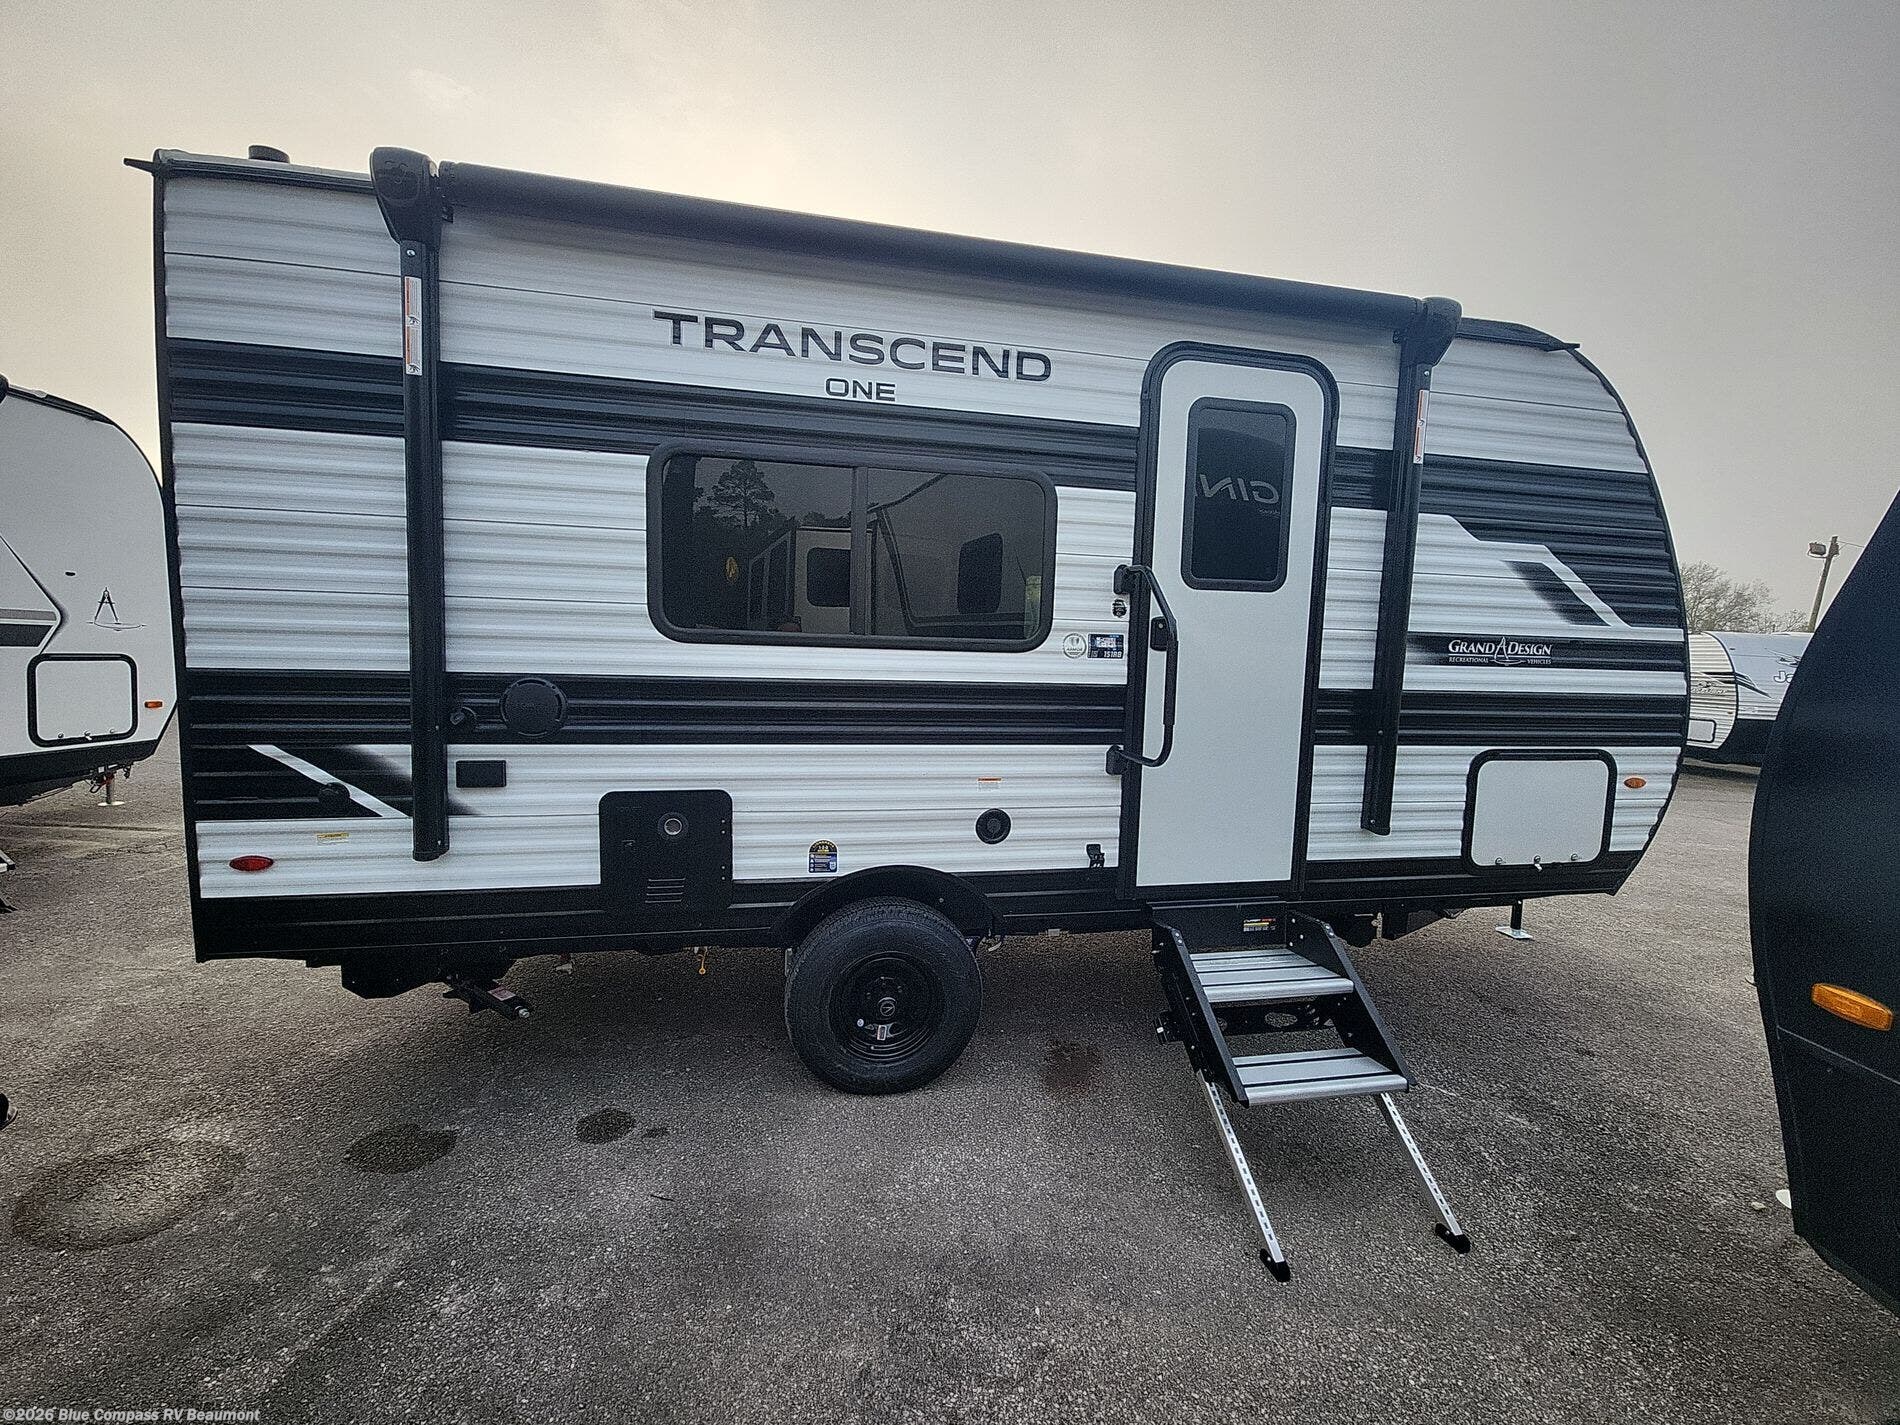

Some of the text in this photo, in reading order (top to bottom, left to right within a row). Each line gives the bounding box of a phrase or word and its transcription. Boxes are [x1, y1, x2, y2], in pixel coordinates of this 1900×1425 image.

[653, 310, 1052, 383] TRANSCEND
[825, 377, 896, 401] ONE
[1448, 639, 1552, 656] GRAND DESIGN
[1448, 656, 1489, 664] RECREATIONAL
